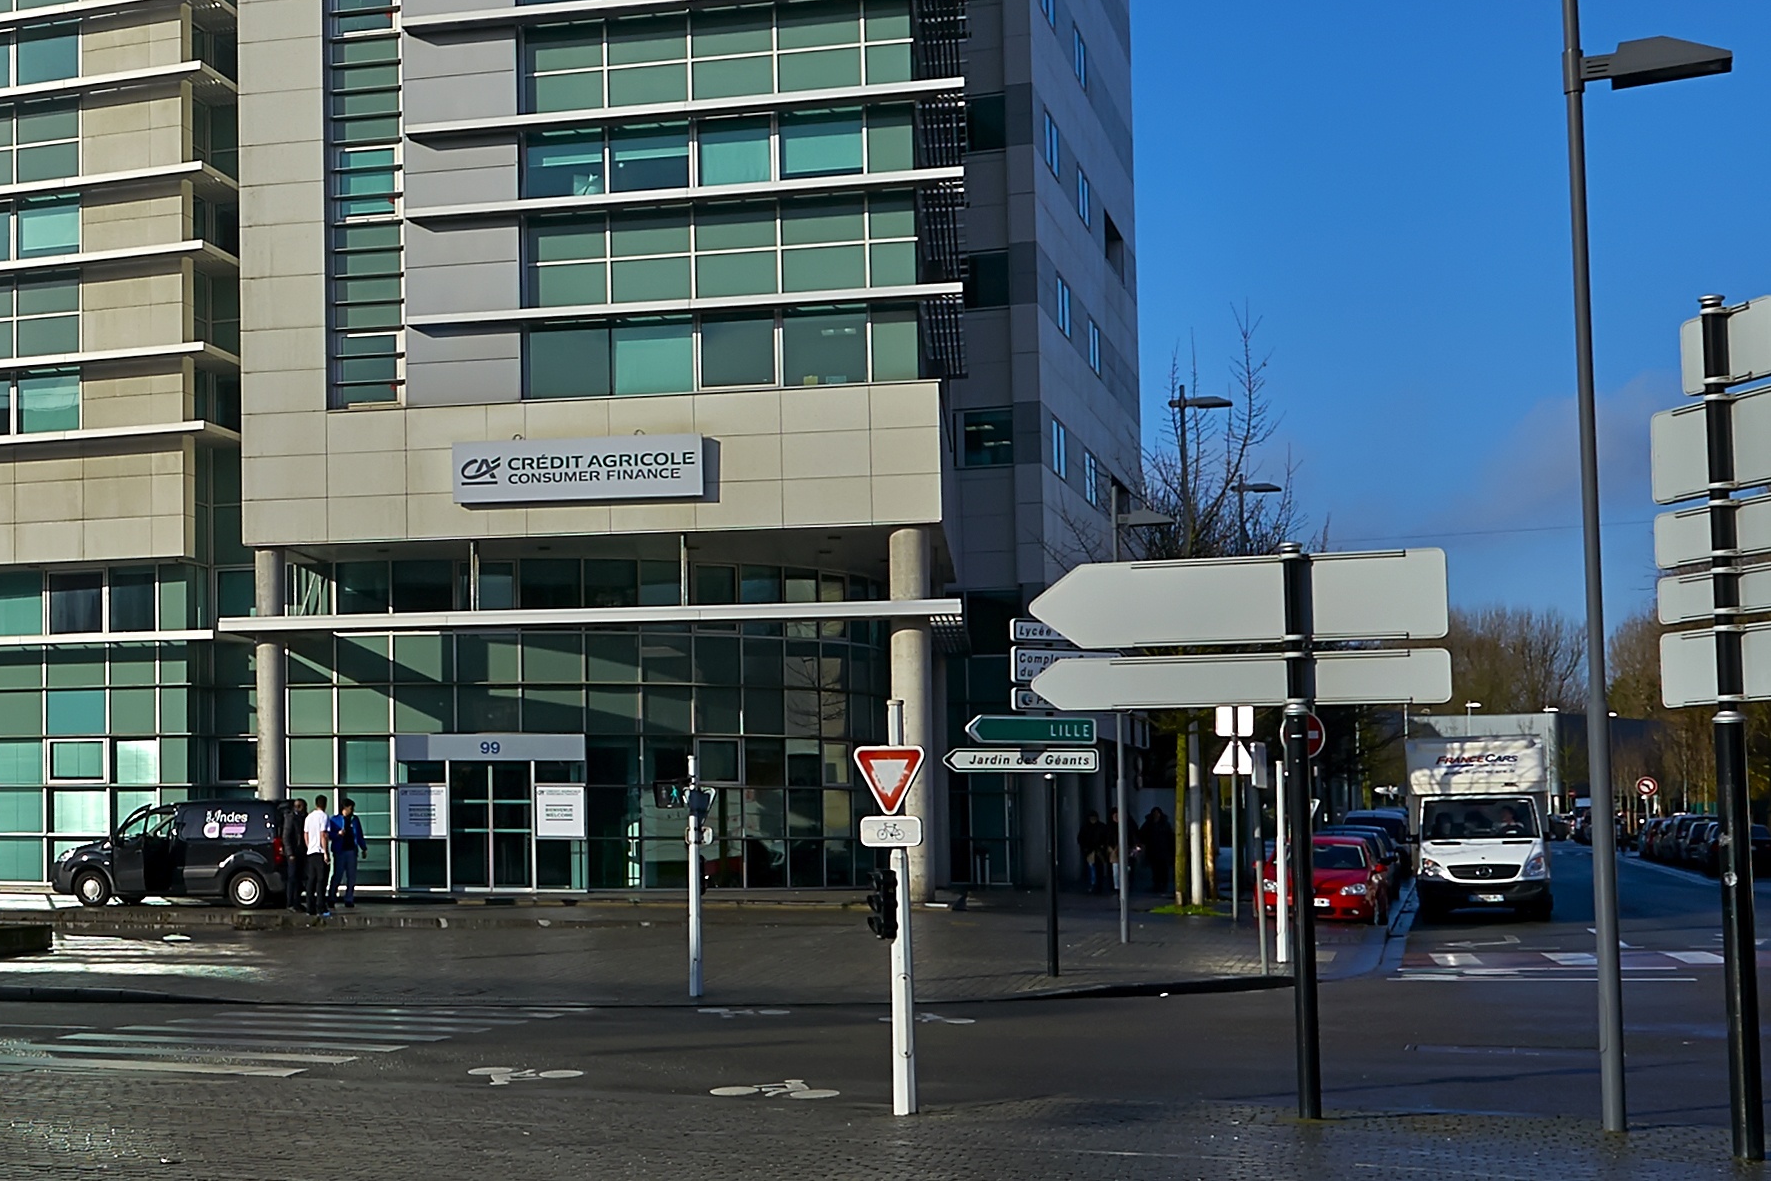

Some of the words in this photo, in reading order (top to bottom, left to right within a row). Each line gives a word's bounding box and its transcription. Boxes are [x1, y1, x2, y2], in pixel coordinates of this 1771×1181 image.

[507, 454, 583, 471] CRÉDIT
[588, 451, 696, 469] AGRICOLE
[507, 470, 601, 485] CONSUMER
[606, 467, 681, 481] FINANCE
[1019, 625, 1052, 637] Lycée
[1020, 669, 1033, 677] du
[1050, 724, 1090, 737] LILLE
[480, 741, 501, 755] 99
[969, 755, 1010, 765] Jardin
[1016, 754, 1037, 765] des
[1045, 754, 1090, 765] Géants
